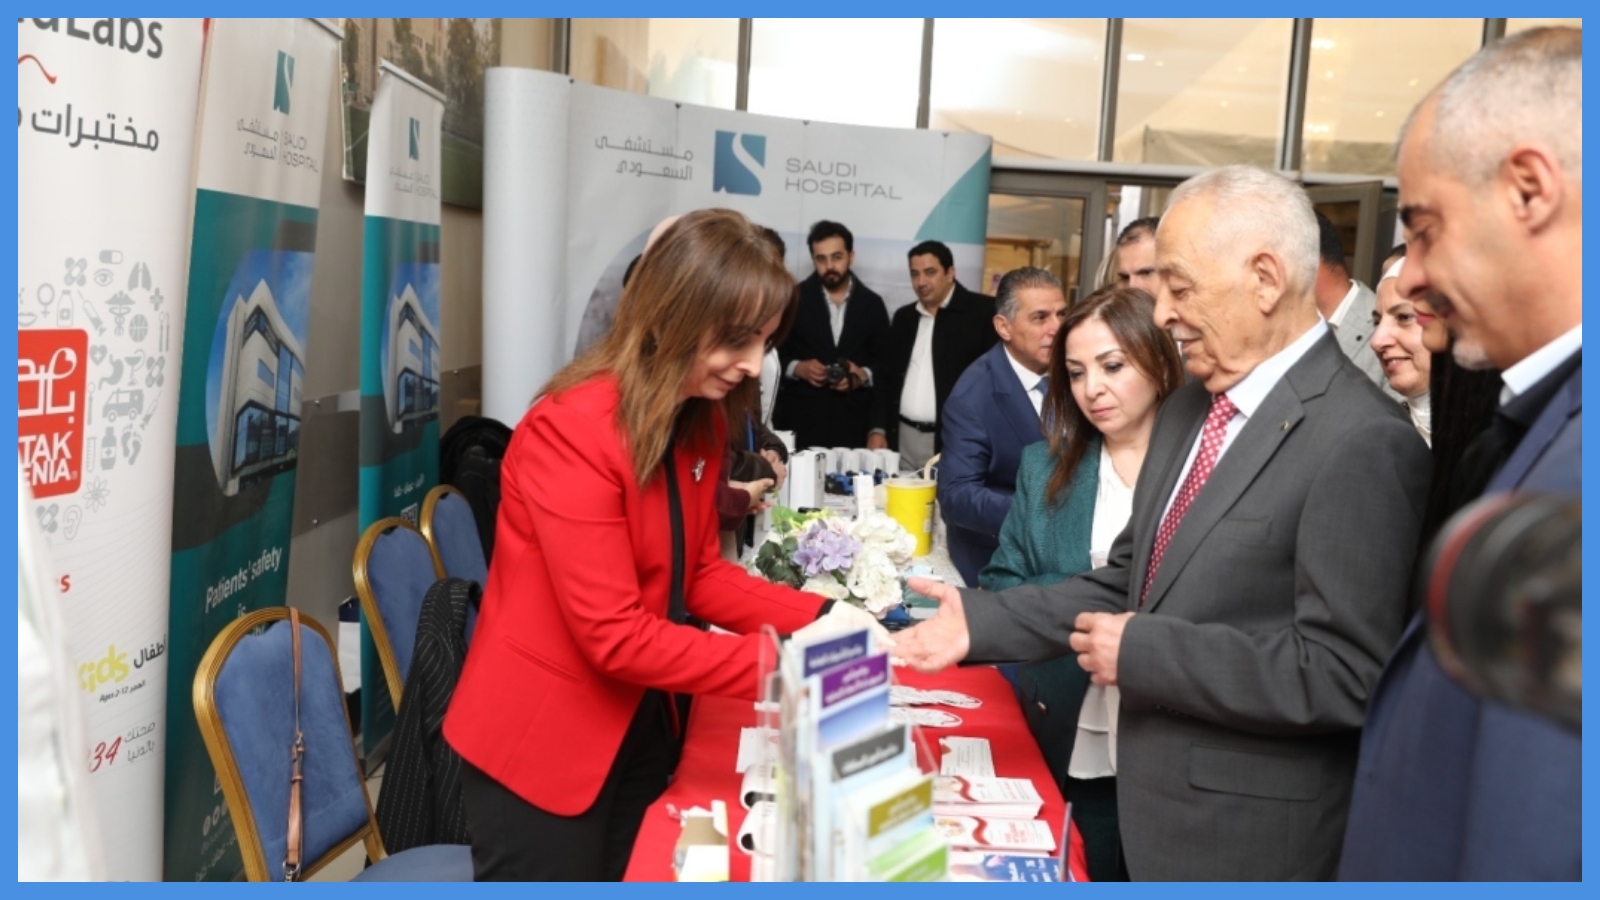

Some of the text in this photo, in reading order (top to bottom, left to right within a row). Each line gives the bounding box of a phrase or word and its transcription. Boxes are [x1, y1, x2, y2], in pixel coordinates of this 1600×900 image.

[31, 103, 159, 152] مختبرات
[282, 130, 308, 151] SAUDI
[282, 151, 319, 173] HOSPITAL
[616, 160, 693, 180] السعودي
[785, 157, 857, 178] SAUDI
[785, 177, 902, 200] HOSPITAL
[18, 430, 73, 469] TAK
[251, 545, 283, 580] safety
[124, 721, 156, 743] صحتك
